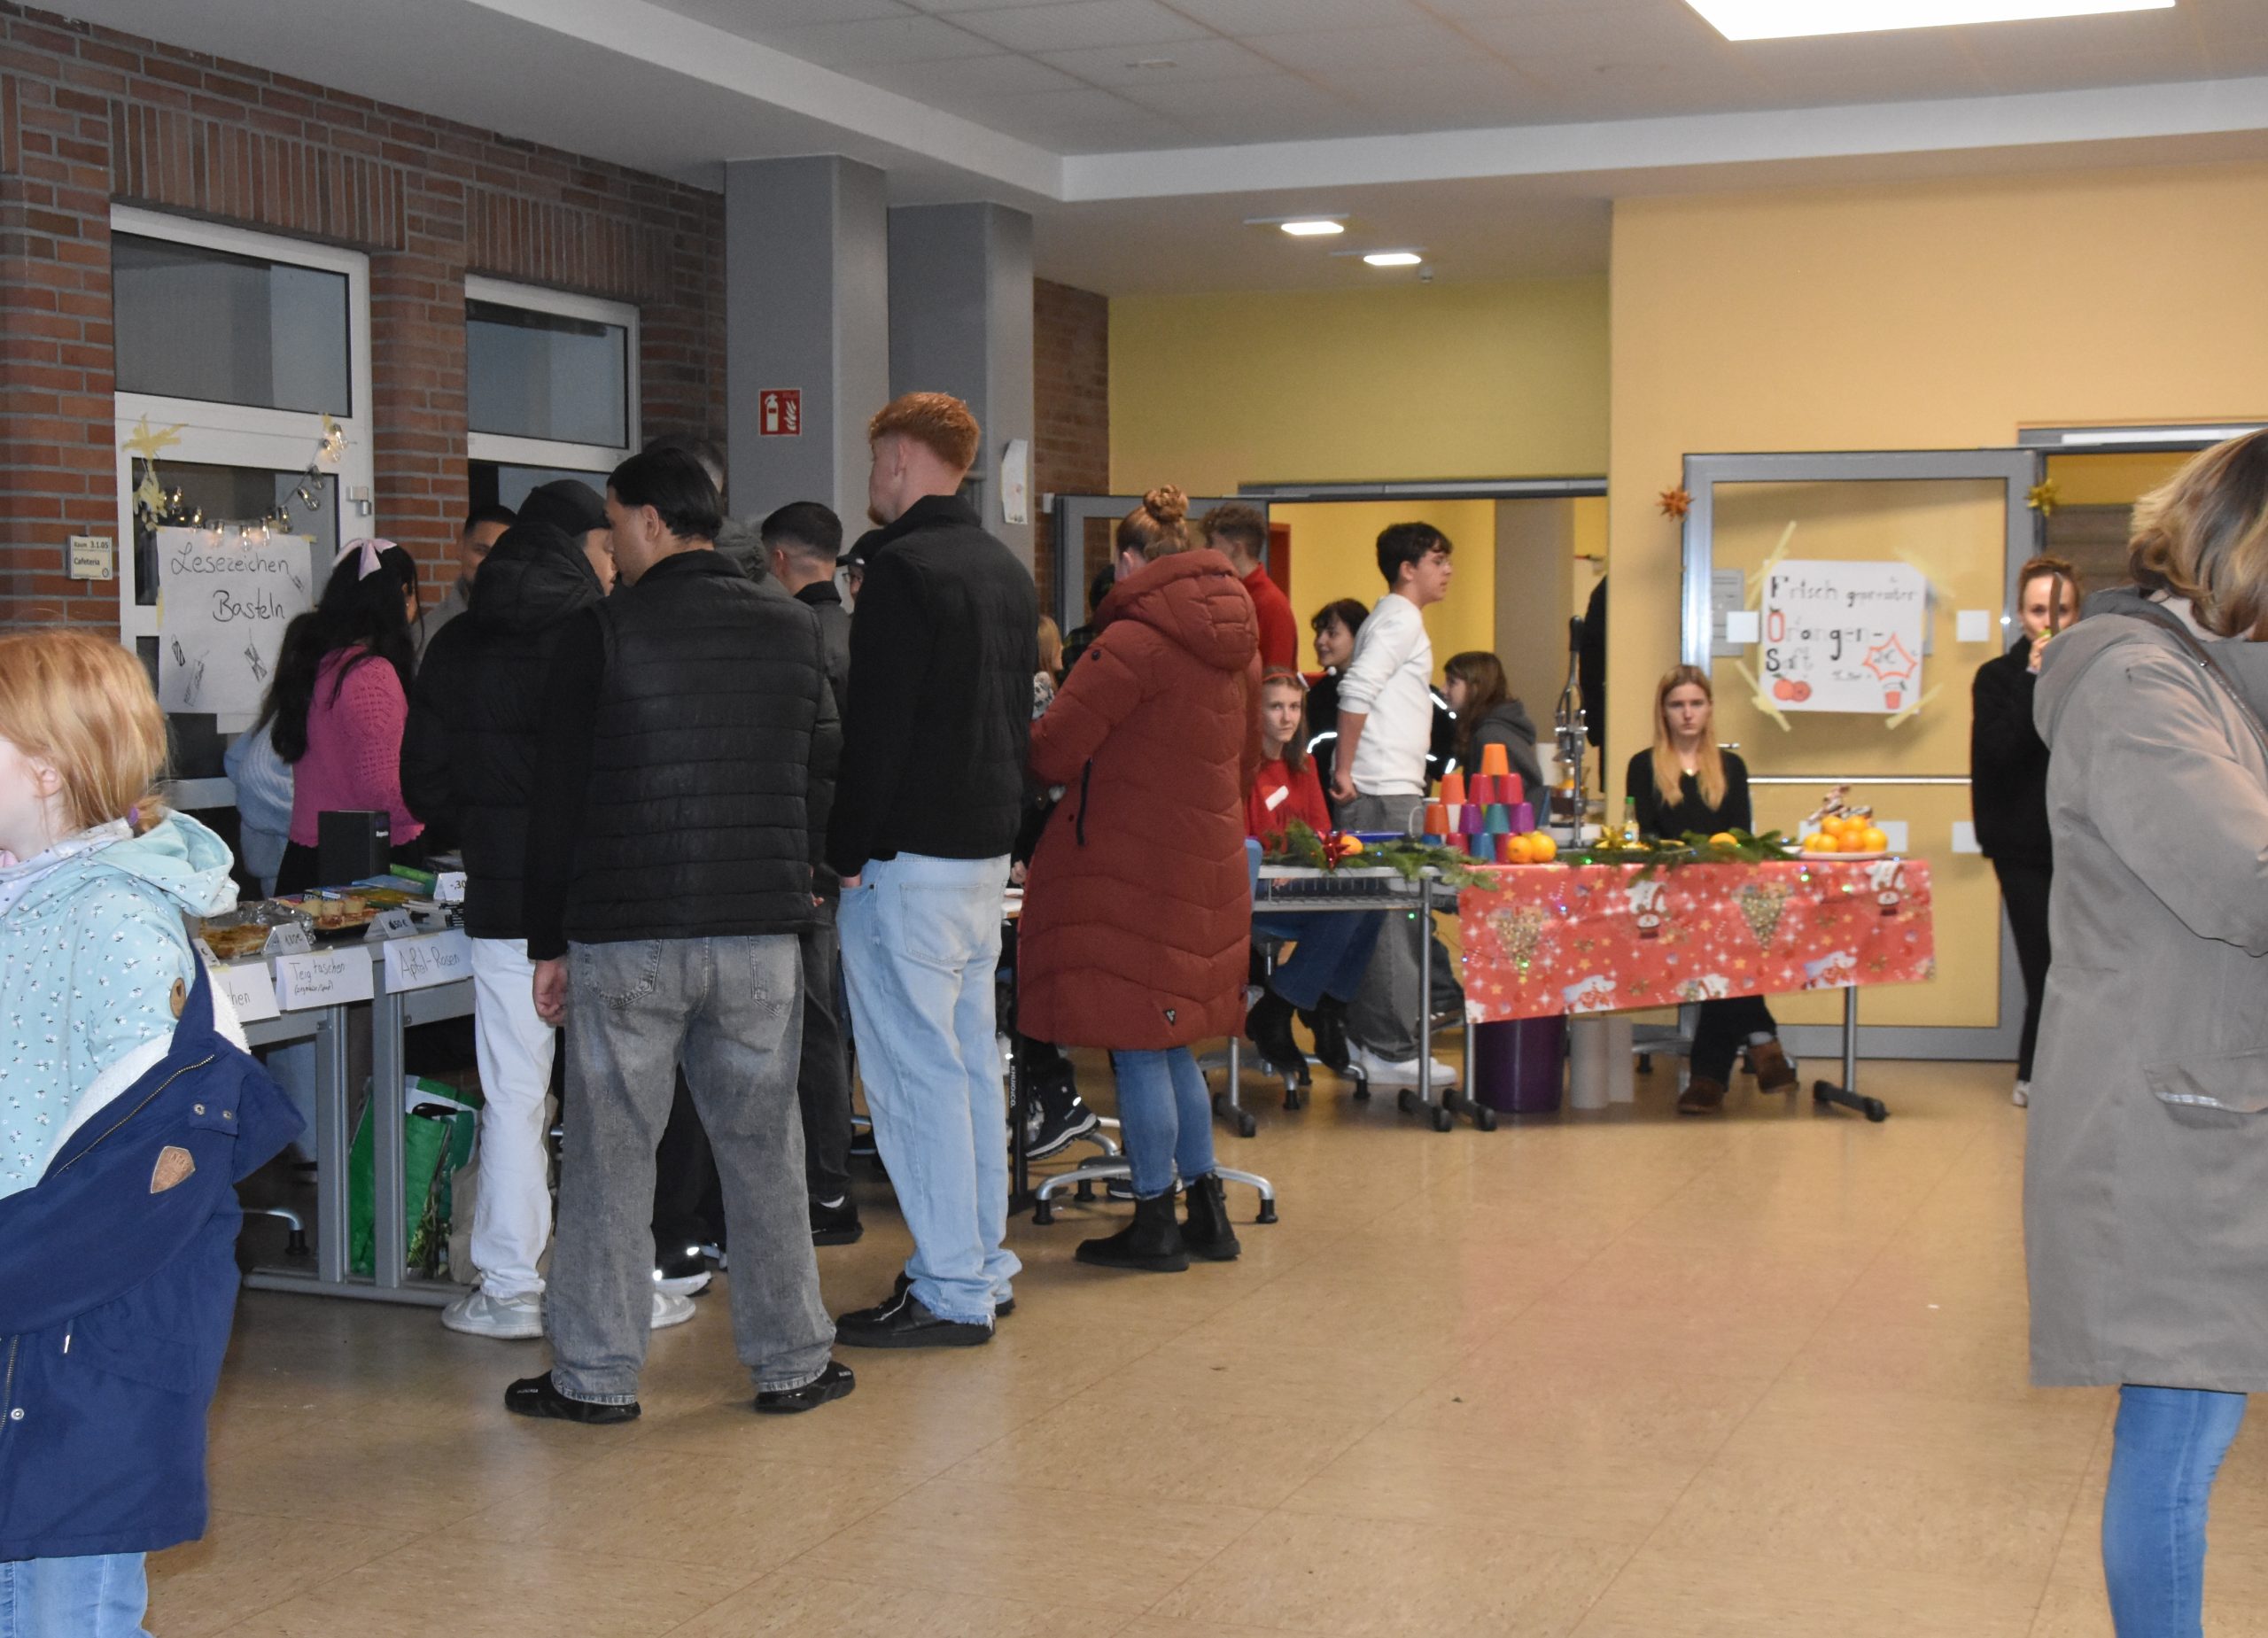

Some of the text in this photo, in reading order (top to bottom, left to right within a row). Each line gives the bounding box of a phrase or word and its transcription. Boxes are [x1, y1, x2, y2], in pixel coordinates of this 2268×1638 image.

[90, 540, 109, 549] 3.1.05
[74, 557, 101, 566] Cafeteria
[171, 541, 290, 576] Lesezeichen
[1770, 576, 1838, 600] Frisch
[213, 587, 286, 623] Basteln
